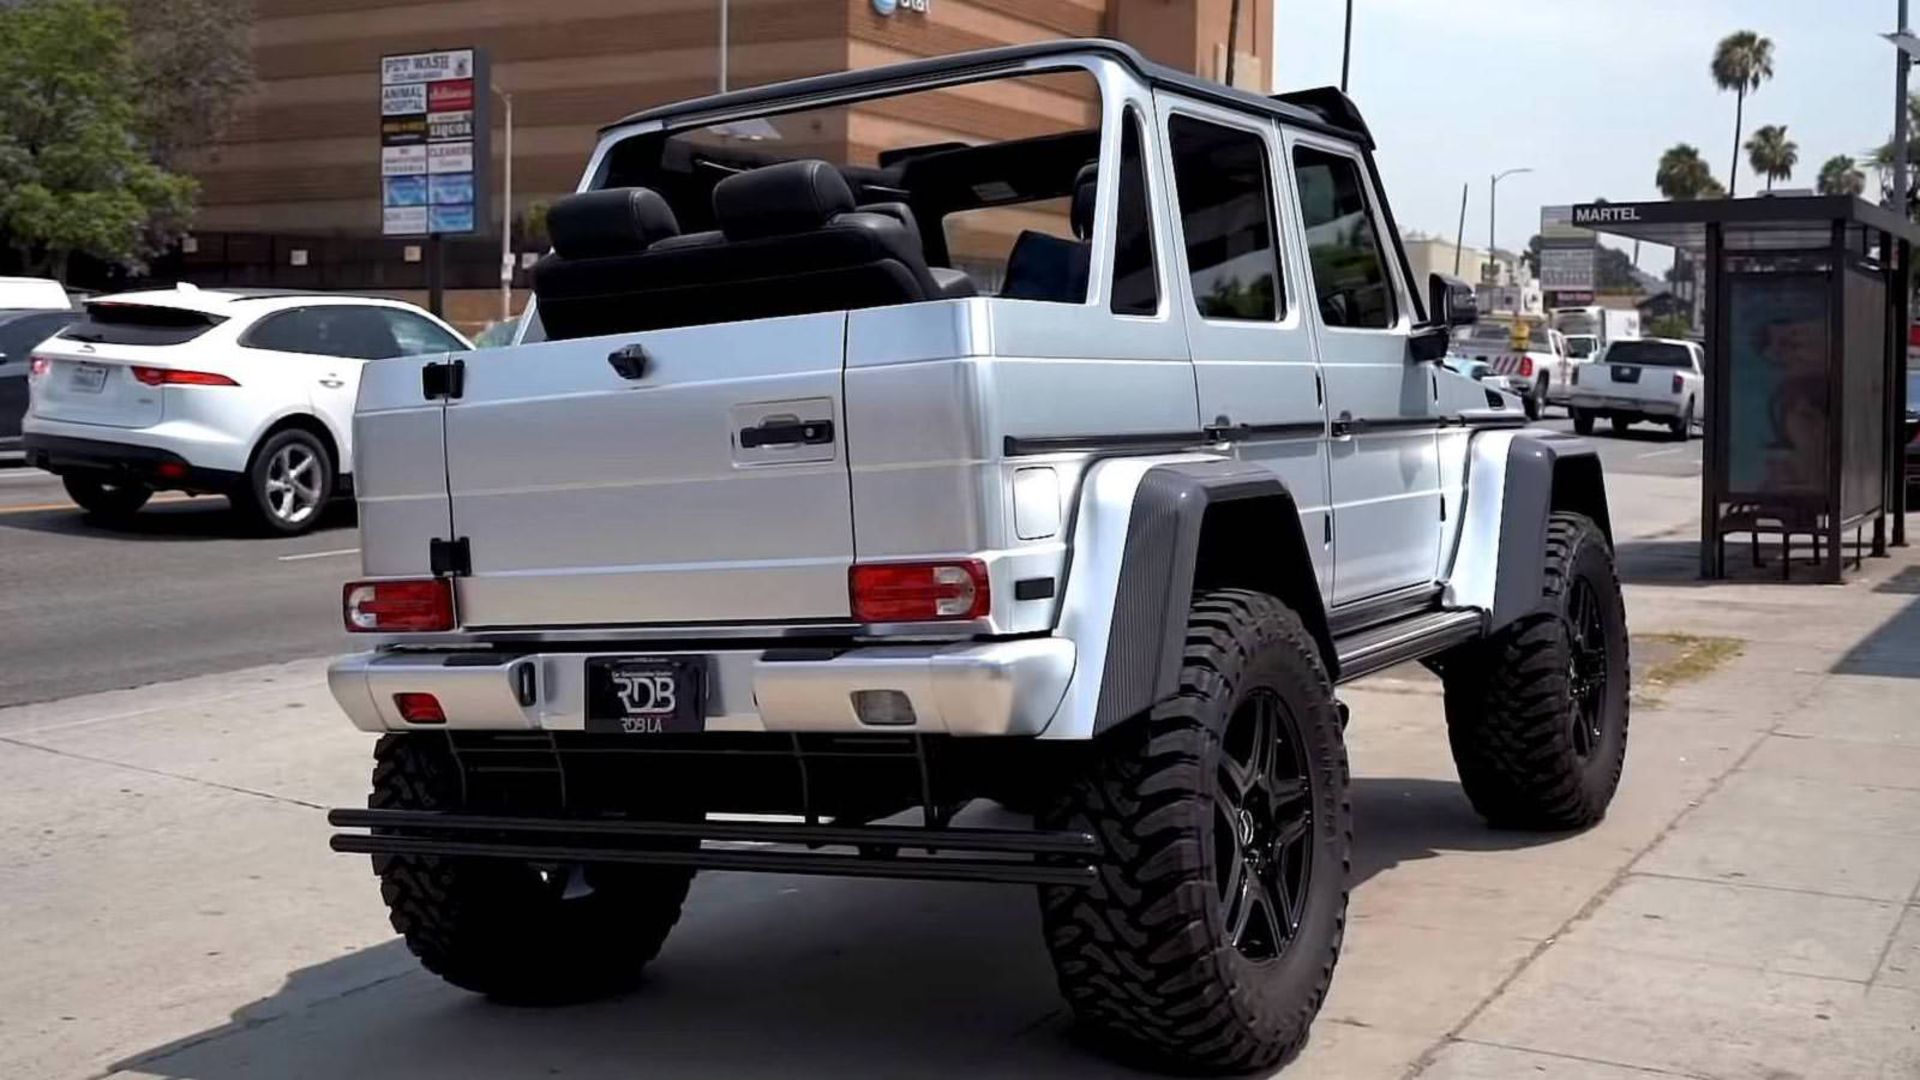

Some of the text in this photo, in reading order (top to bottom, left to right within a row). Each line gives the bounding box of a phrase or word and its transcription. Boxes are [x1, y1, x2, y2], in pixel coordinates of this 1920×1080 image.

[384, 55, 450, 74] PET WASH
[384, 86, 424, 99] ANIMAL
[1576, 207, 1641, 222] MARTEL
[613, 676, 675, 713] RDB
[620, 718, 662, 733] RDB LA
